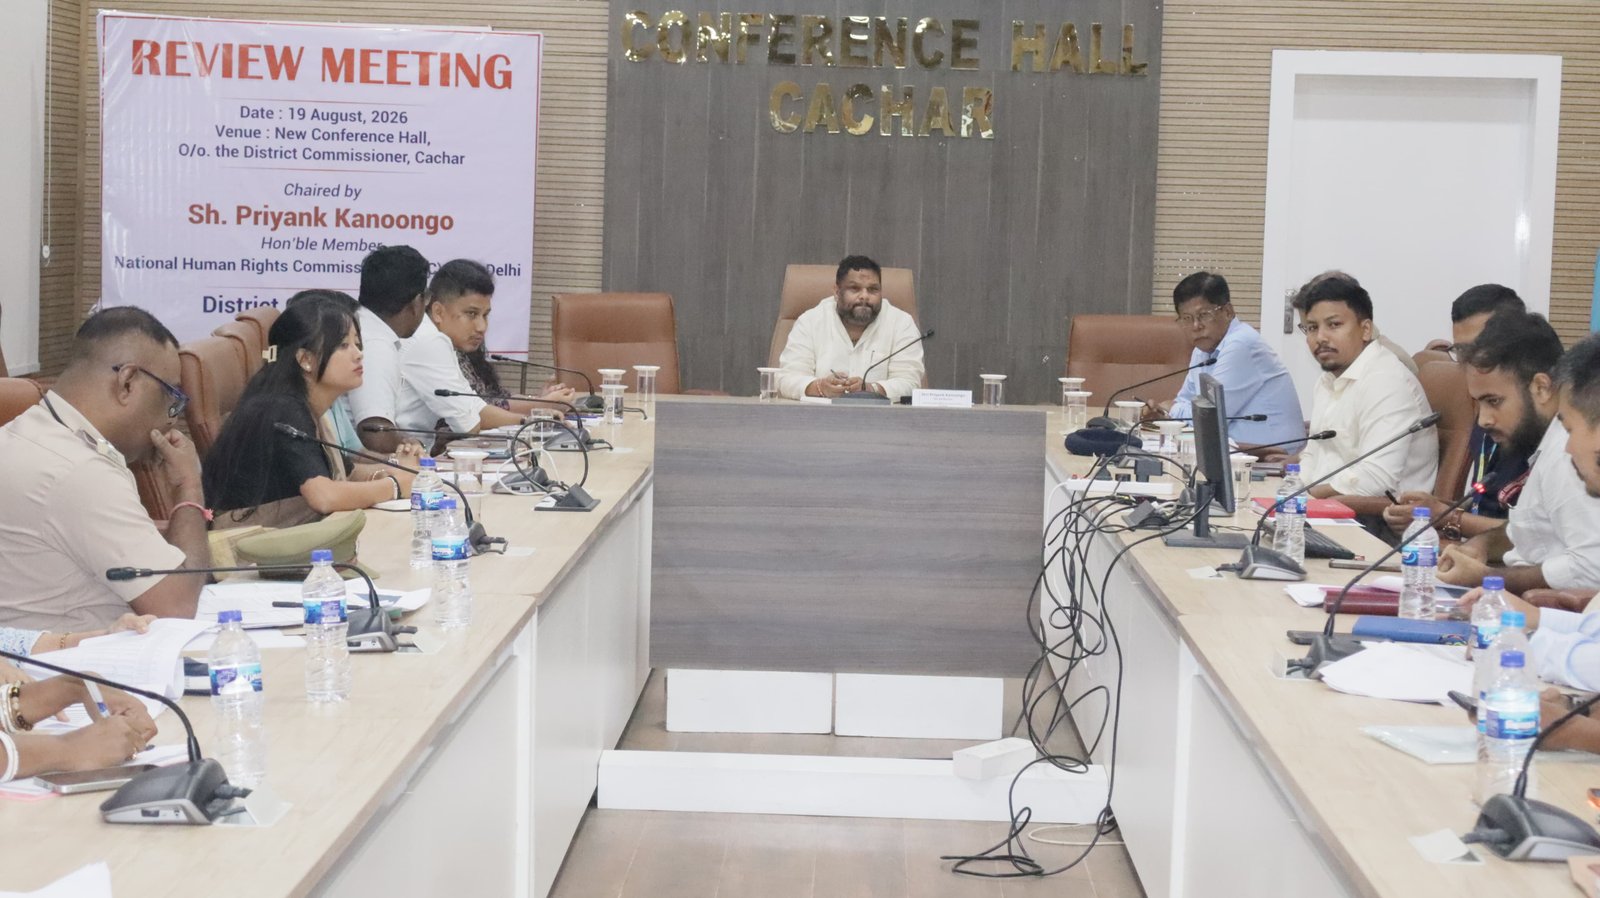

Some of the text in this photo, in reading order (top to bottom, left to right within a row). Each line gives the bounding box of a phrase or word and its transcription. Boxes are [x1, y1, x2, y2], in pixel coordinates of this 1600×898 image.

[621, 10, 1148, 77] CONFERENCE HALL
[132, 38, 513, 90] REVIEW MEETING
[239, 105, 275, 121] Date
[288, 106, 306, 121] 19
[310, 107, 367, 125] August,
[371, 109, 409, 124] 2026
[769, 81, 994, 139] CACHAR
[214, 124, 262, 140] Venue
[274, 126, 308, 141] New
[311, 127, 396, 144] Conference
[398, 130, 431, 146] Hall,
[178, 142, 466, 166] O/o. the District Commissioner, Cachar
[283, 182, 363, 202] Chaired by
[187, 203, 455, 236] Sh. Priyank Kanoongo
[260, 236, 383, 253] Hon'ble Member
[113, 255, 178, 271] National
[182, 256, 237, 272] Human
[240, 257, 289, 276] Rights
[292, 259, 362, 275] Commiss
